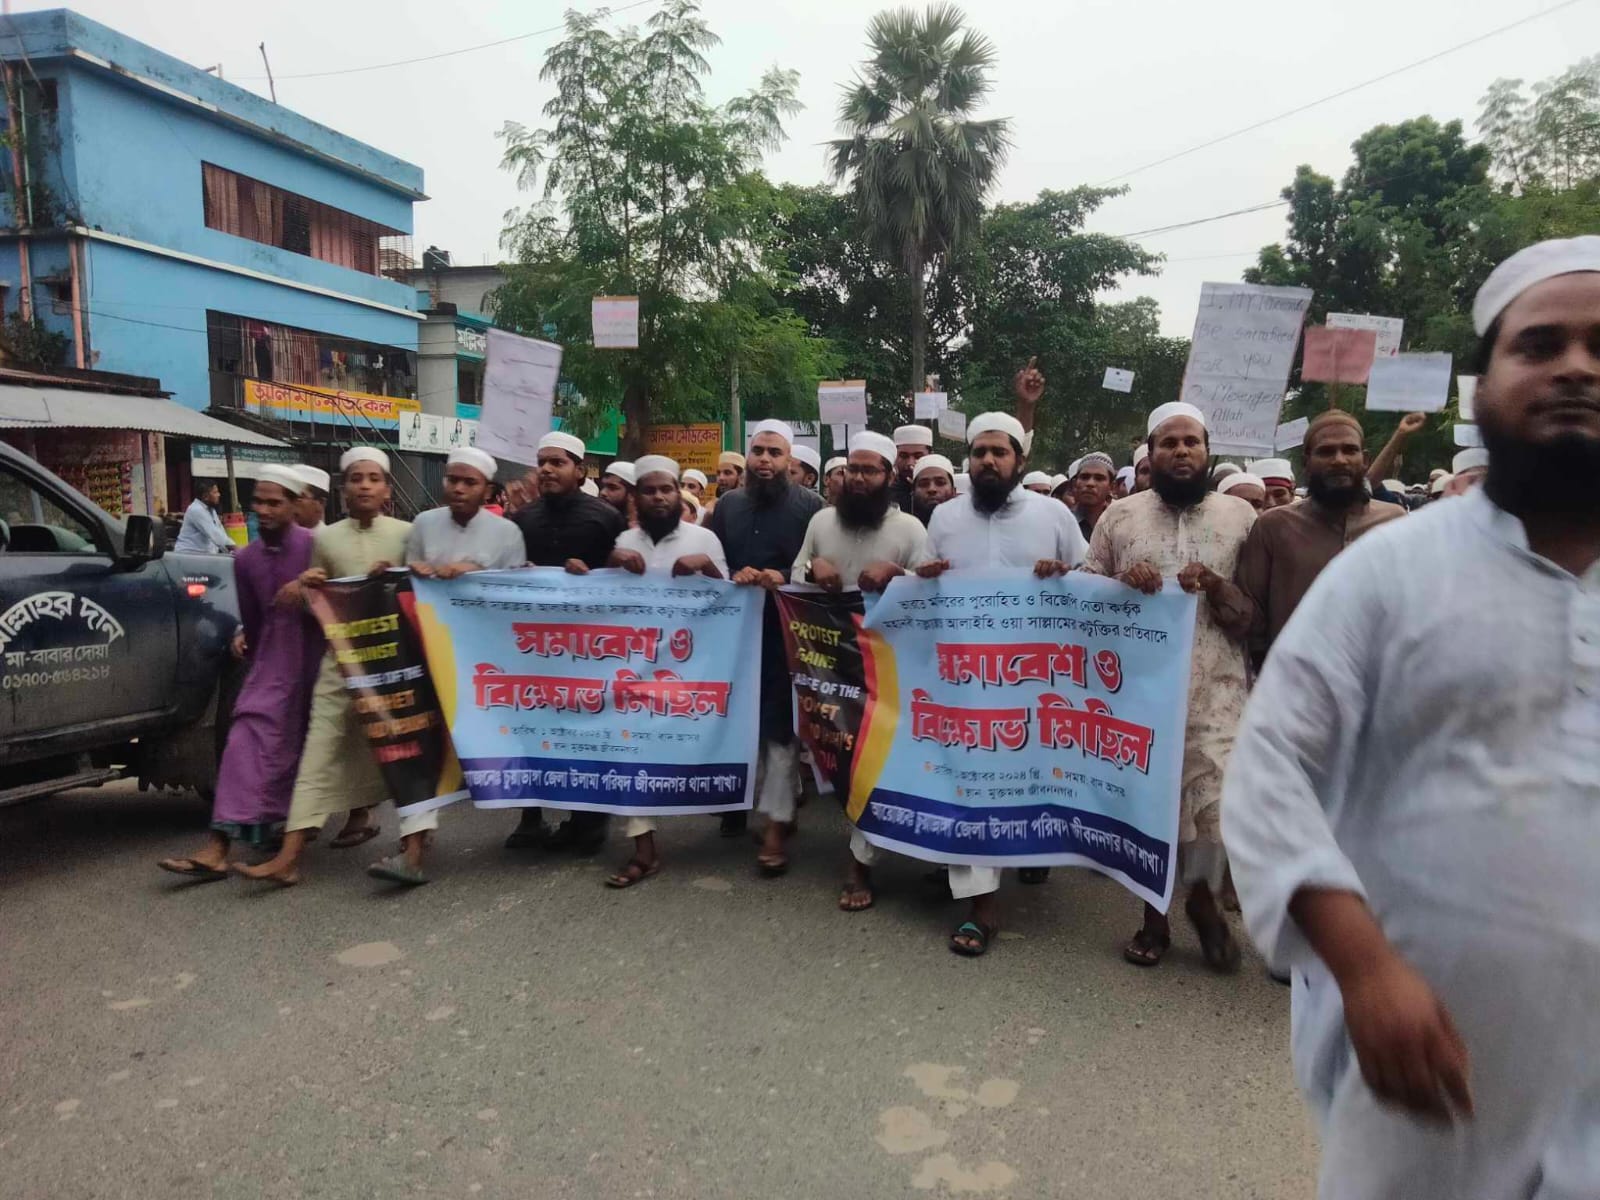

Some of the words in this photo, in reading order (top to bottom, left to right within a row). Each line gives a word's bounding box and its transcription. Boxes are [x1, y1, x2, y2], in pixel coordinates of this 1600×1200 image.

[968, 591, 1021, 610] পুরোহিত
[1026, 594, 1036, 607] ও
[80, 596, 125, 645] দান
[789, 620, 842, 648] PROTEST
[669, 627, 694, 662] ও
[935, 641, 1088, 691] সমাবেশ
[1092, 648, 1124, 694] ও
[612, 667, 732, 720] মিছিল
[820, 681, 838, 696] OF
[839, 684, 861, 699] THE
[910, 687, 1031, 753] বিক্ষোভ
[1036, 692, 1155, 777] মিছিল
[543, 770, 568, 790] জেলা
[569, 766, 600, 790] উলামা
[601, 768, 633, 792] পরিষদ
[633, 769, 688, 794] জীবননগর
[688, 775, 711, 793] থানা
[954, 820, 987, 841] জেলা
[988, 814, 1029, 841] উলামা
[1030, 811, 1070, 839] পরিষদ
